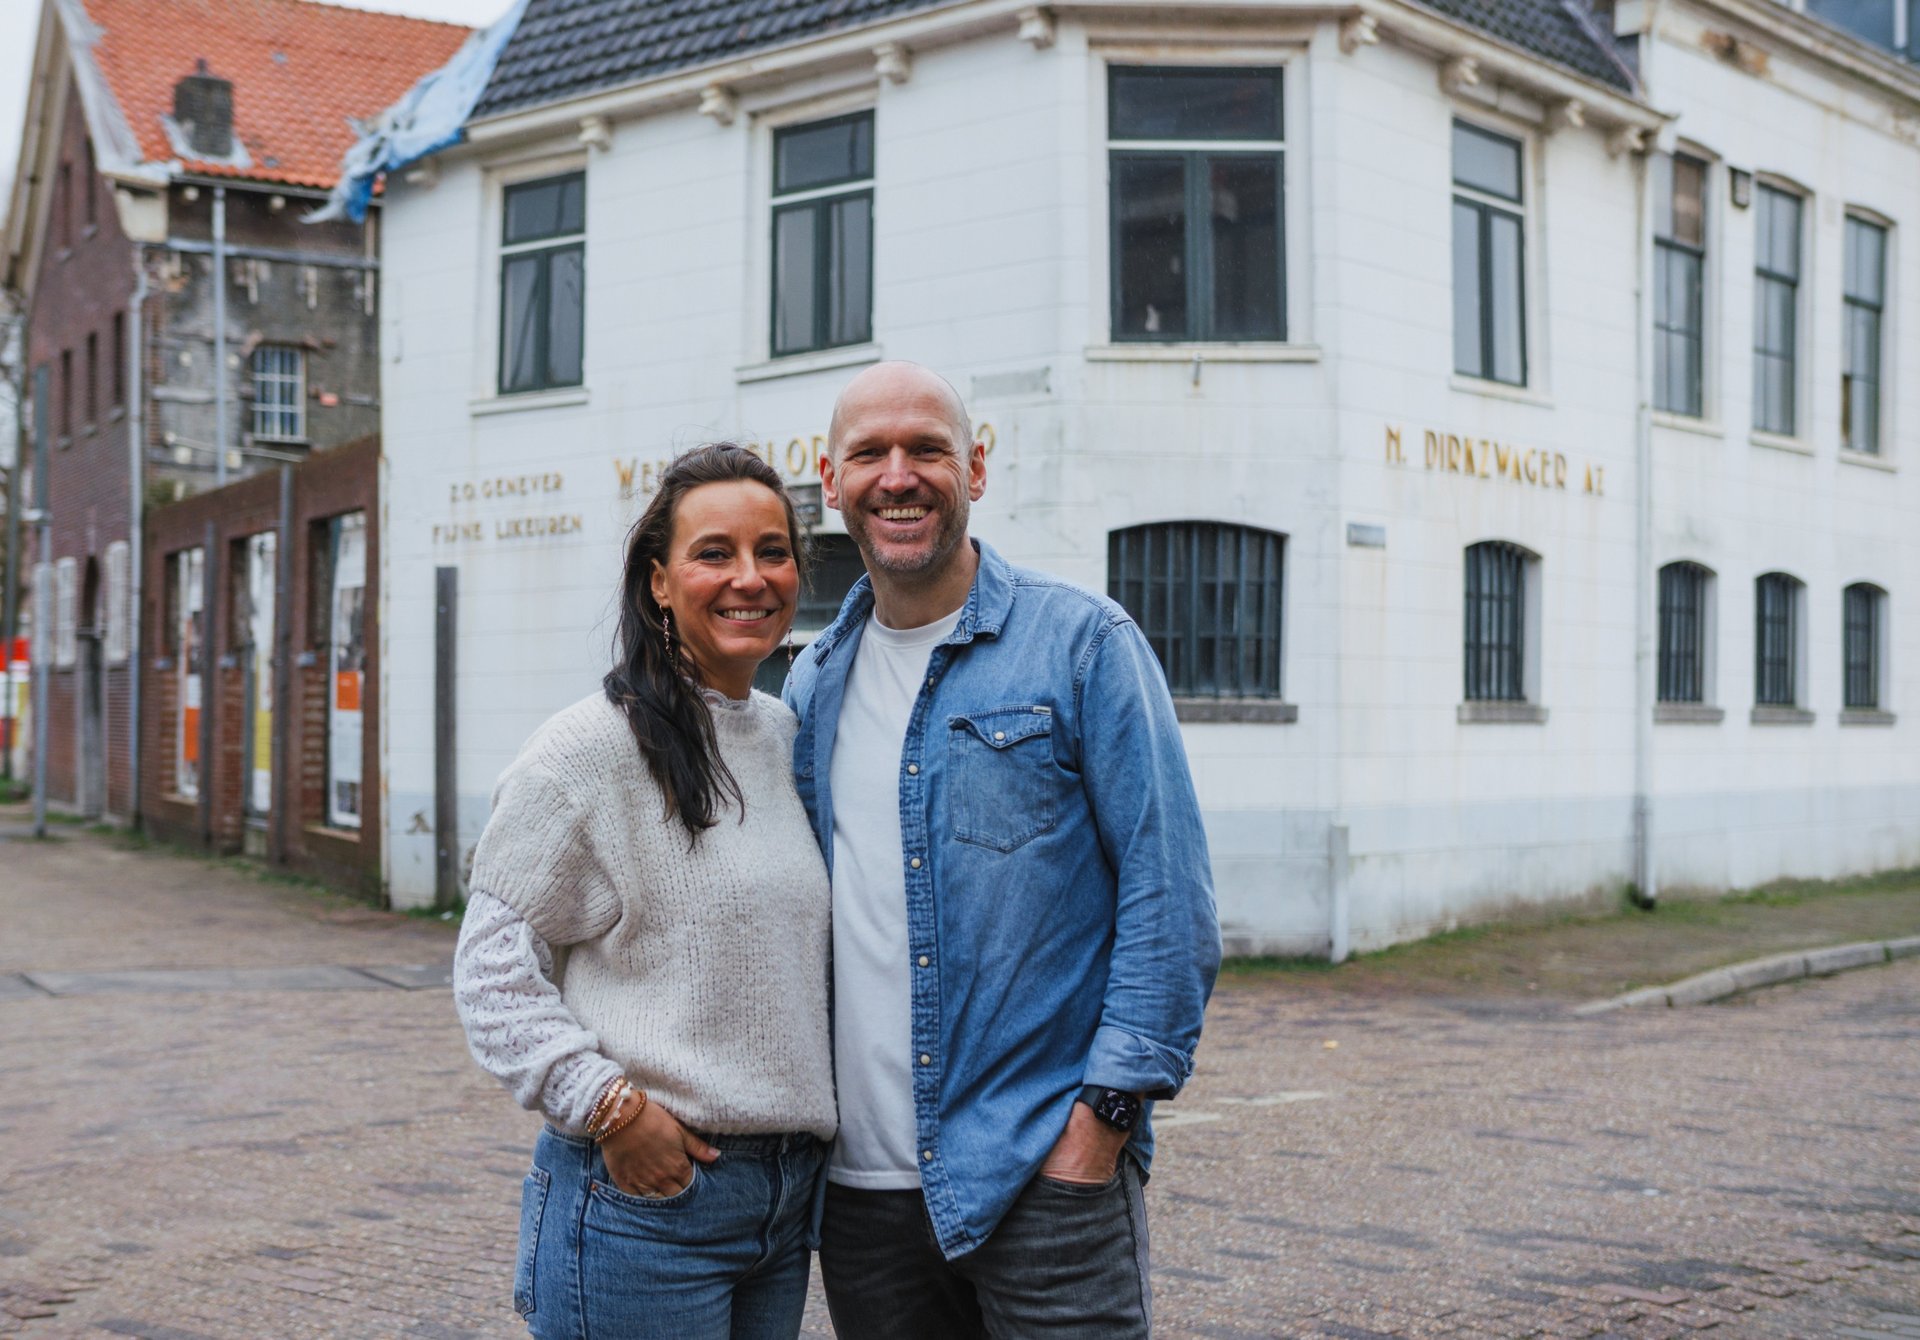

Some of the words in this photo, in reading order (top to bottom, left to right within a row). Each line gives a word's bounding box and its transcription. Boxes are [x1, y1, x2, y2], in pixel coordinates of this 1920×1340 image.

[1423, 429, 1568, 489] DIRKZWAGER
[481, 471, 563, 499] GENEVER
[496, 513, 583, 541] LIKEUREN
